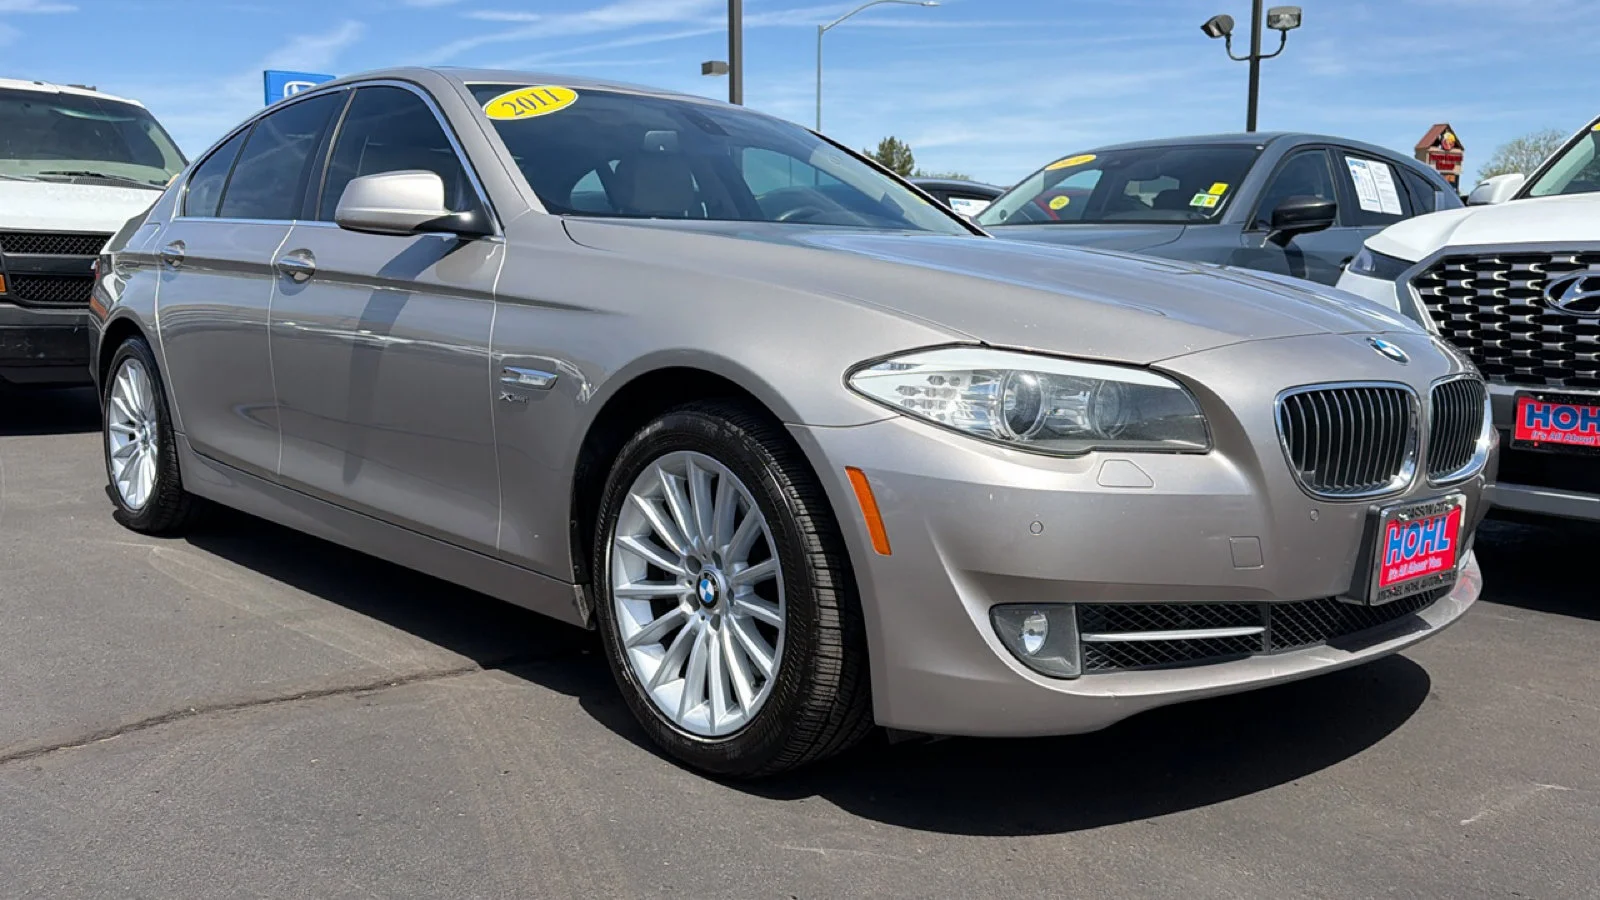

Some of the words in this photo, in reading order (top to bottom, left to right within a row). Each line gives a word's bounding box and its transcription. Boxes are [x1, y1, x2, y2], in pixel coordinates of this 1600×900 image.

[501, 89, 560, 115] 2011
[1531, 430, 1547, 441] It's
[1549, 431, 1563, 441] All
[1564, 433, 1595, 443] About
[1385, 516, 1450, 566] HOHL
[1388, 568, 1398, 581] It's
[1399, 563, 1408, 576] All
[1409, 560, 1428, 574] About
